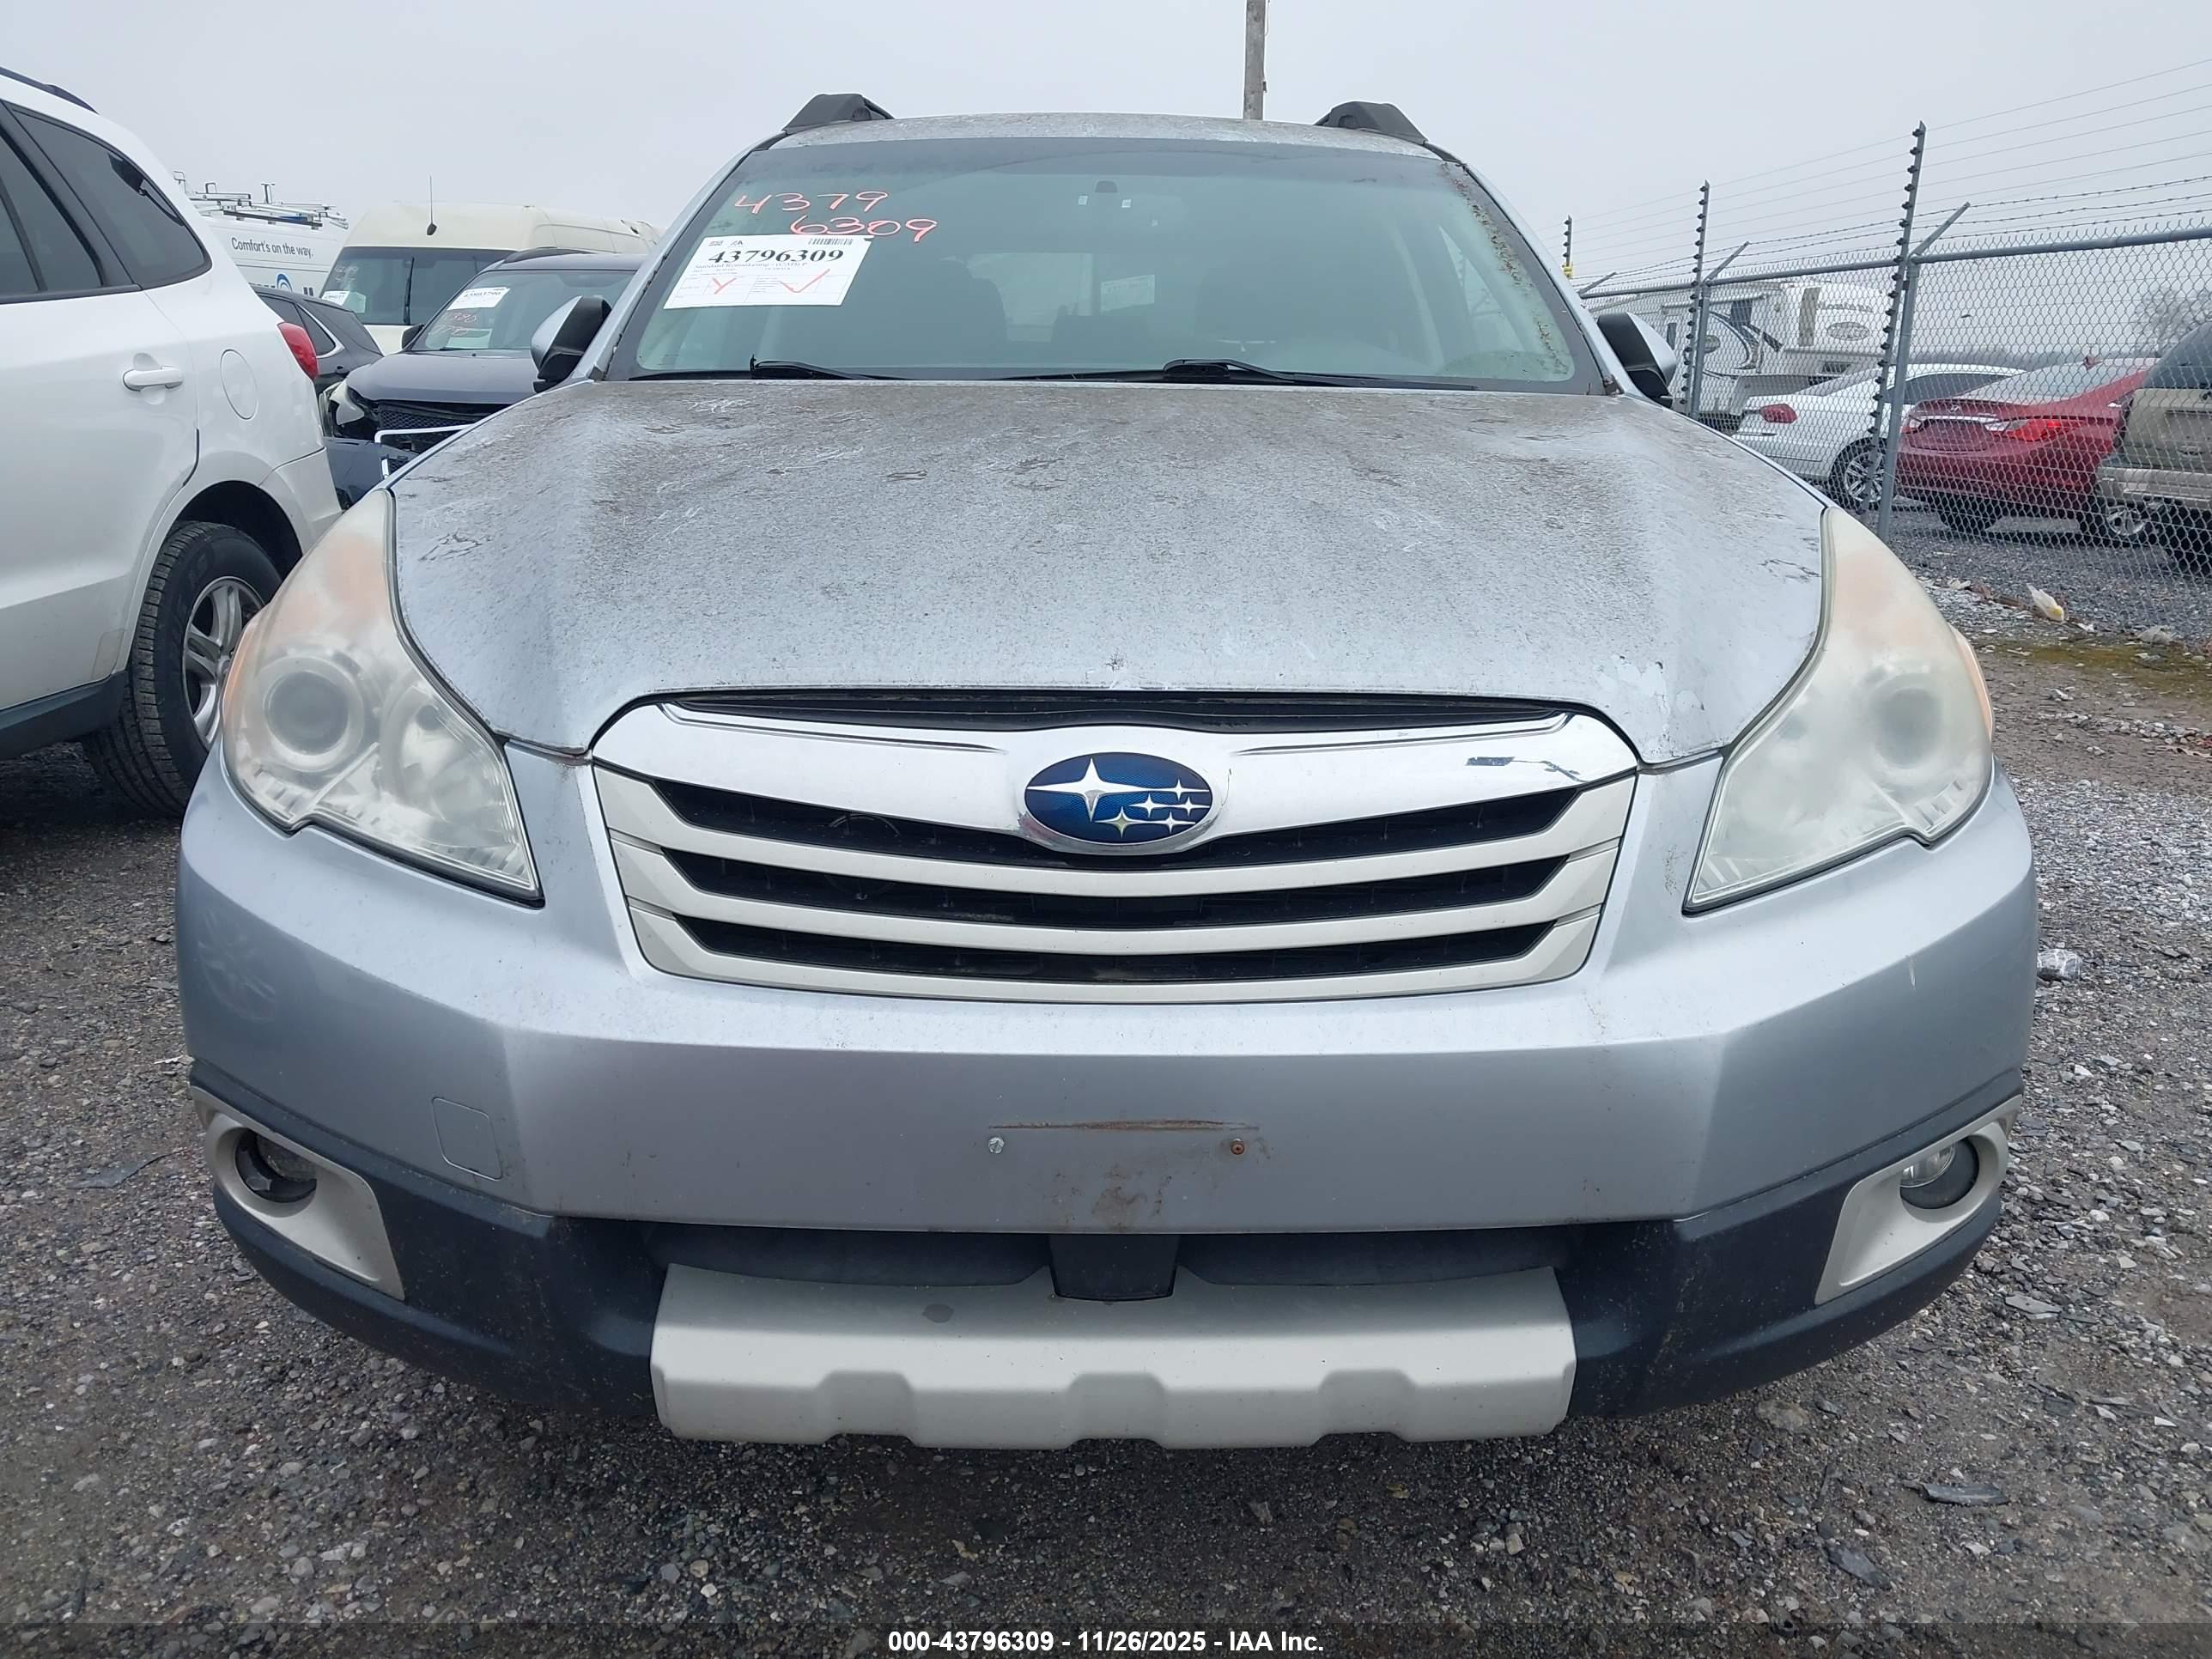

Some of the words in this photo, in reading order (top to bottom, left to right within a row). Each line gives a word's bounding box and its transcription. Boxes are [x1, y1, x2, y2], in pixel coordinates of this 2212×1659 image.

[734, 191, 889, 214] 4379
[790, 215, 939, 243] 6309
[231, 237, 270, 253] Comfort's
[271, 244, 283, 254] on
[283, 243, 296, 255] the
[296, 247, 313, 258] way.
[708, 249, 844, 264] 43796309
